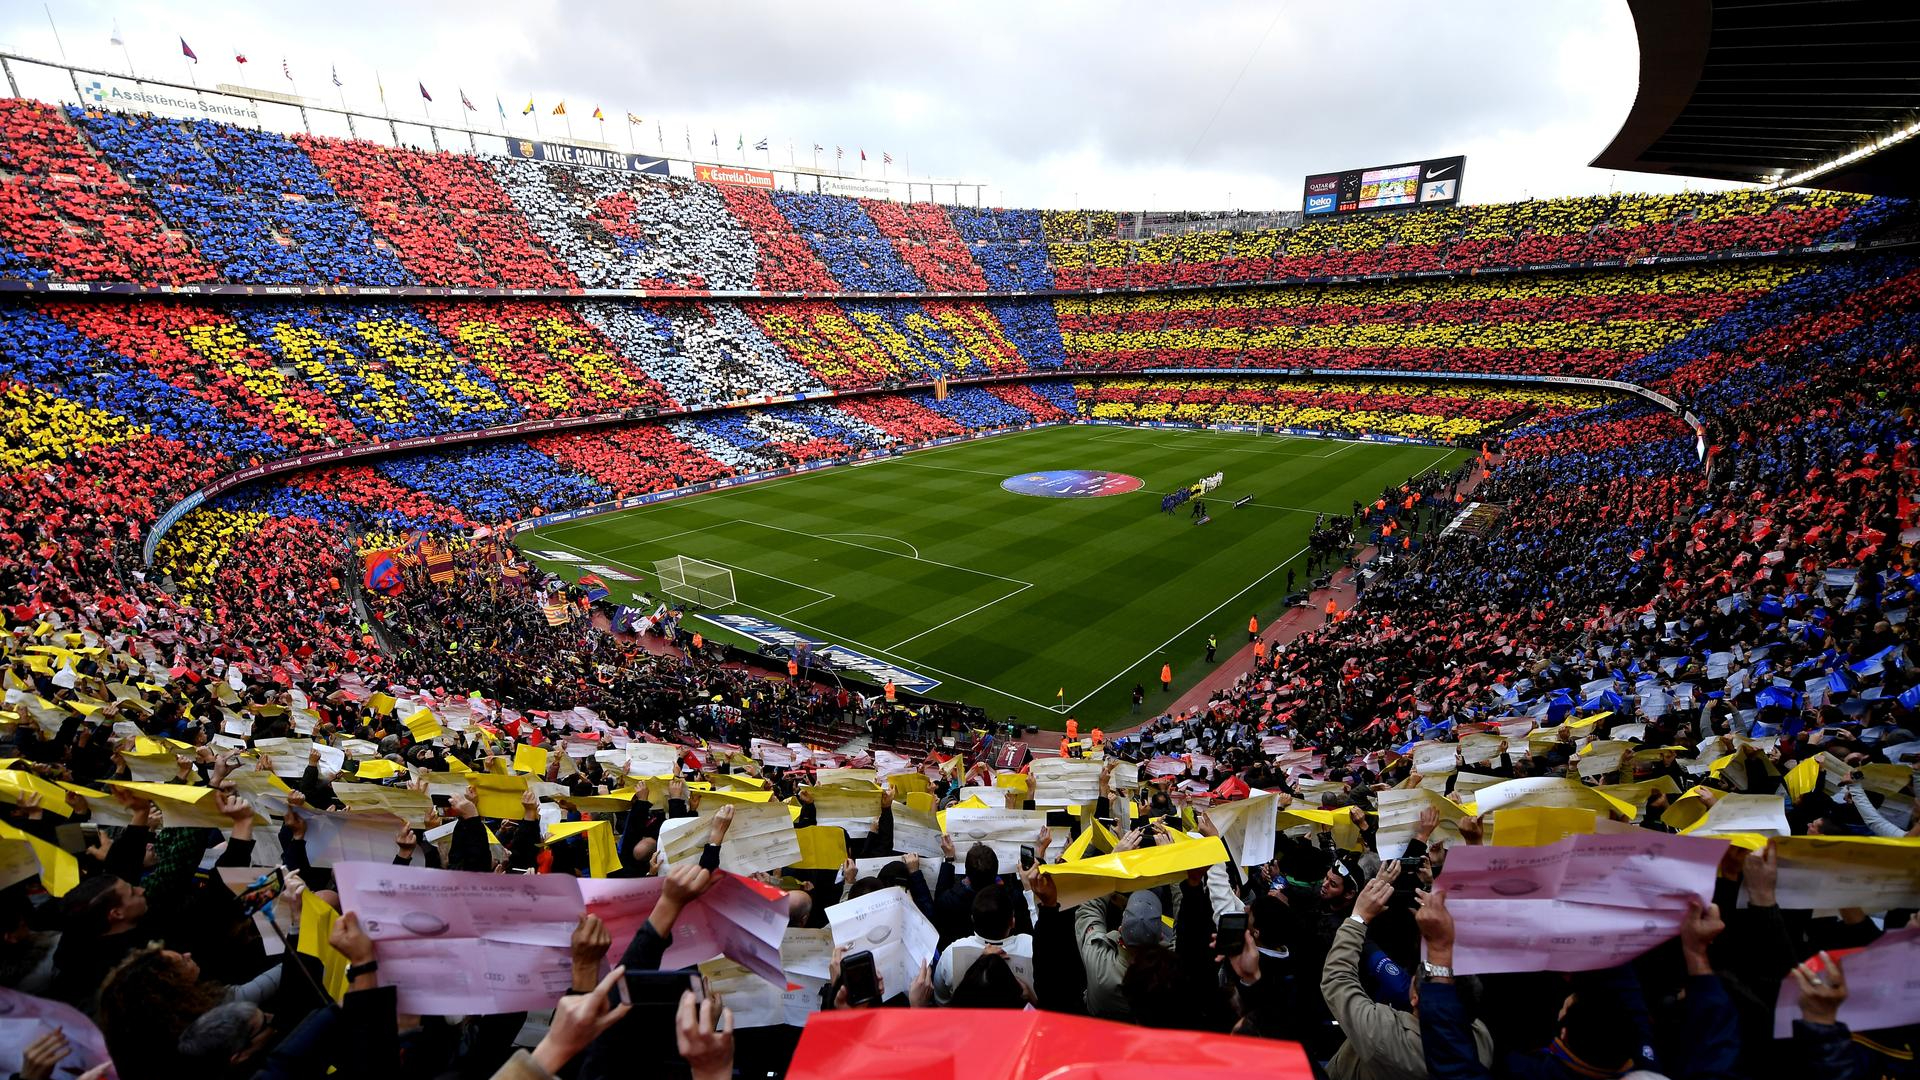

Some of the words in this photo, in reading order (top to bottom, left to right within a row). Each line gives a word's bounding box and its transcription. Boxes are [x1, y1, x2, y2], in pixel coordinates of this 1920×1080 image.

[112, 87, 197, 111] Assistència
[199, 101, 258, 119] Sanitària
[542, 144, 628, 170] NIKE.COM/FCB
[711, 170, 745, 183] Estrella
[745, 173, 771, 186] Damm
[1310, 182, 1329, 190] QATAR
[1310, 197, 1332, 206] beko
[1660, 255, 1707, 263] FCBARCELONA.COM
[48, 283, 90, 291] NIKE.COM/FCB
[410, 884, 460, 892] BARCELONA
[481, 885, 515, 893] MADRID
[367, 921, 380, 932] 2
[847, 942, 855, 950] 2
